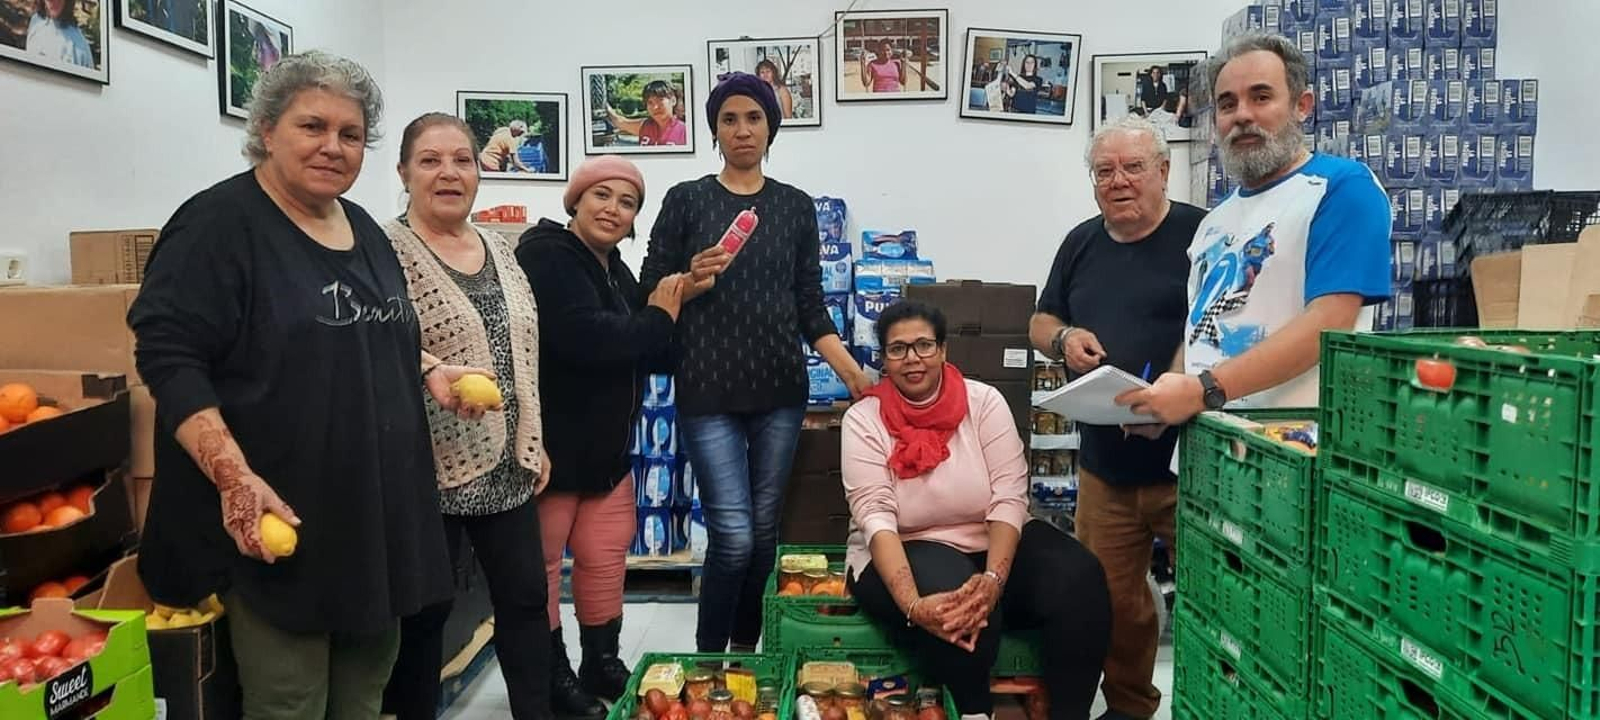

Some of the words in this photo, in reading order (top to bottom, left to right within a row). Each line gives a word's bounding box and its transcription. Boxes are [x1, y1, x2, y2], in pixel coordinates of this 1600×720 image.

[815, 202, 831, 212] VA
[864, 301, 889, 313] PU
[49, 665, 88, 705] Sweet
